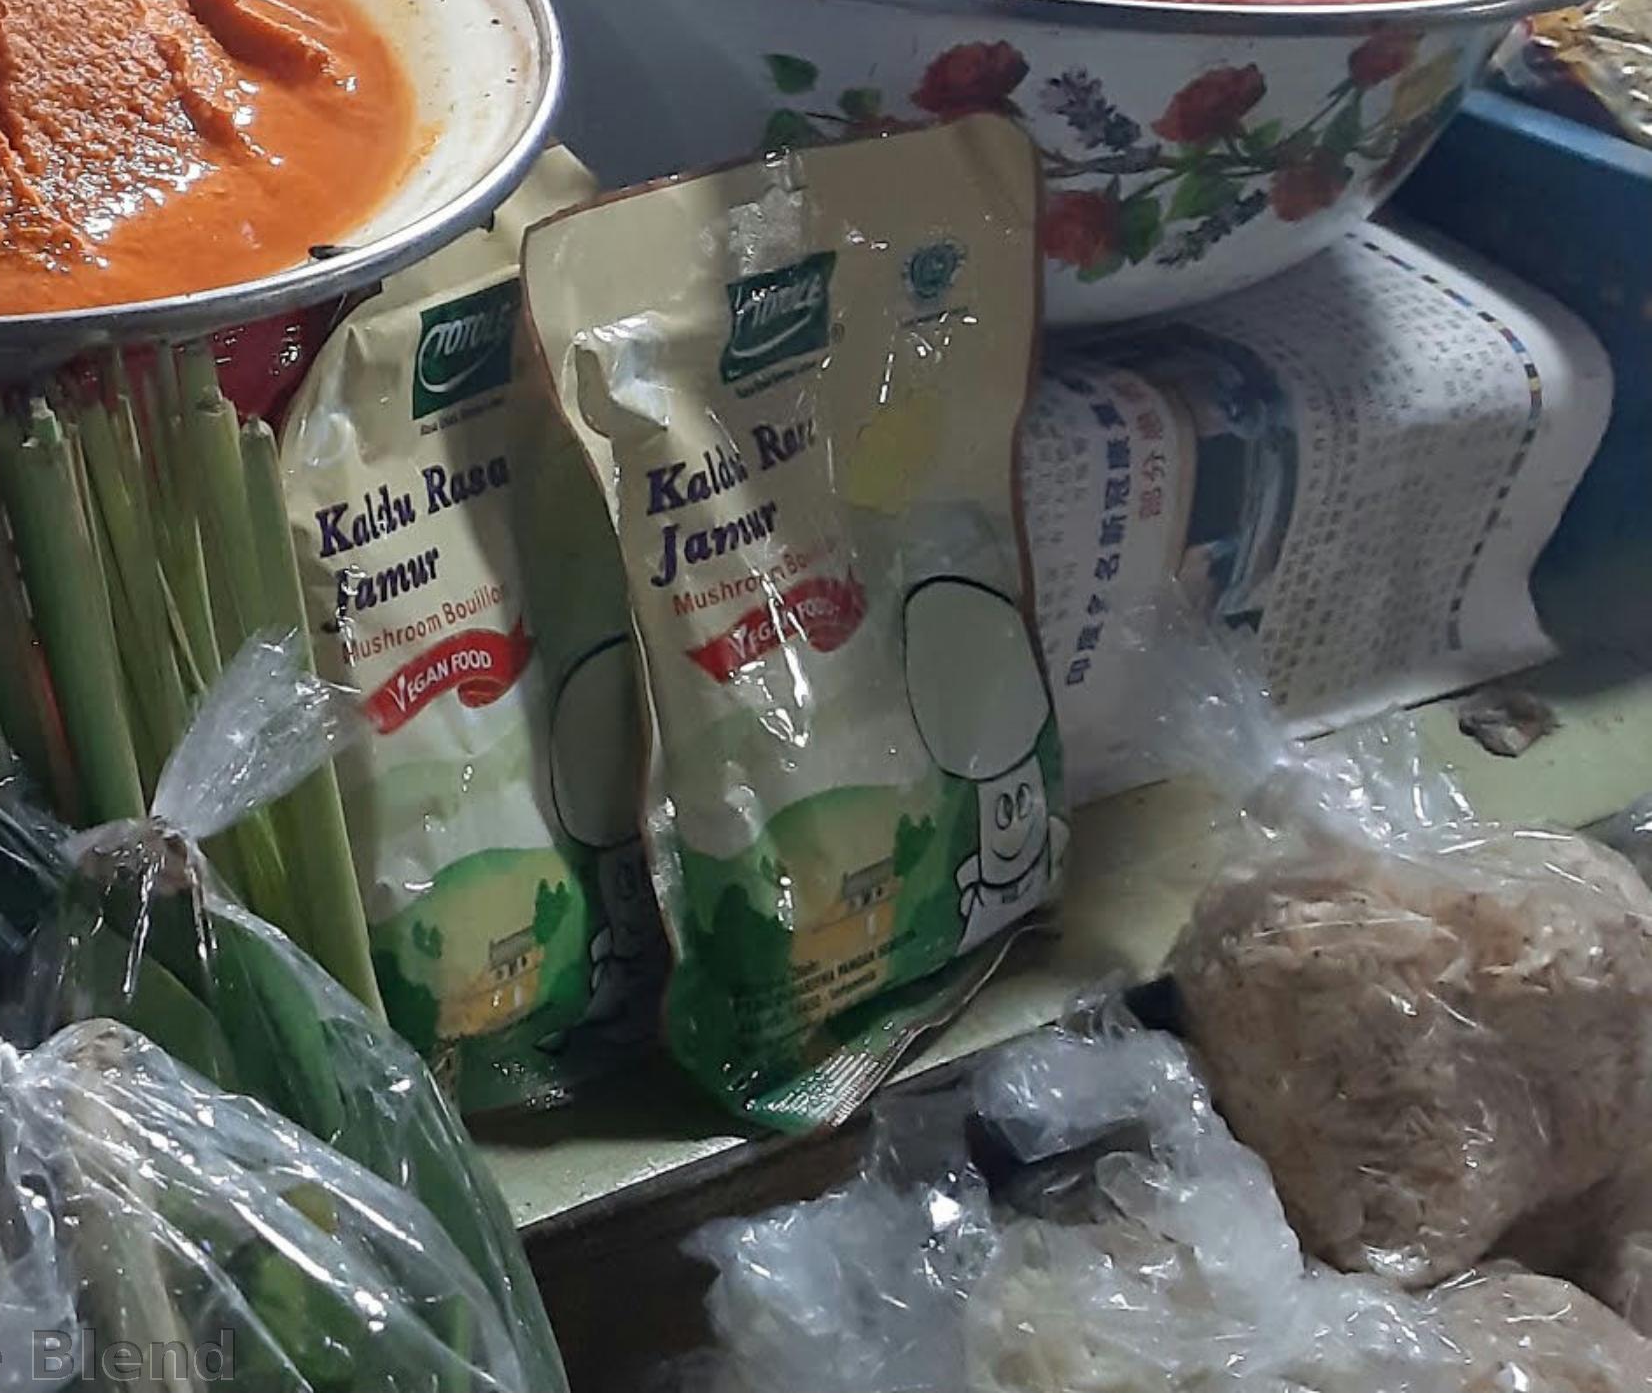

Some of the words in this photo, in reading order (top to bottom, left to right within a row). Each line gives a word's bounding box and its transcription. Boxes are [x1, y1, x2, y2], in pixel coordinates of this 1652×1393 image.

[315, 483, 416, 557] Kaldu
[421, 456, 509, 515] Rasa
[651, 501, 777, 588] Jamur
[388, 661, 449, 712] VEGAN
[451, 649, 492, 673] FOOD
